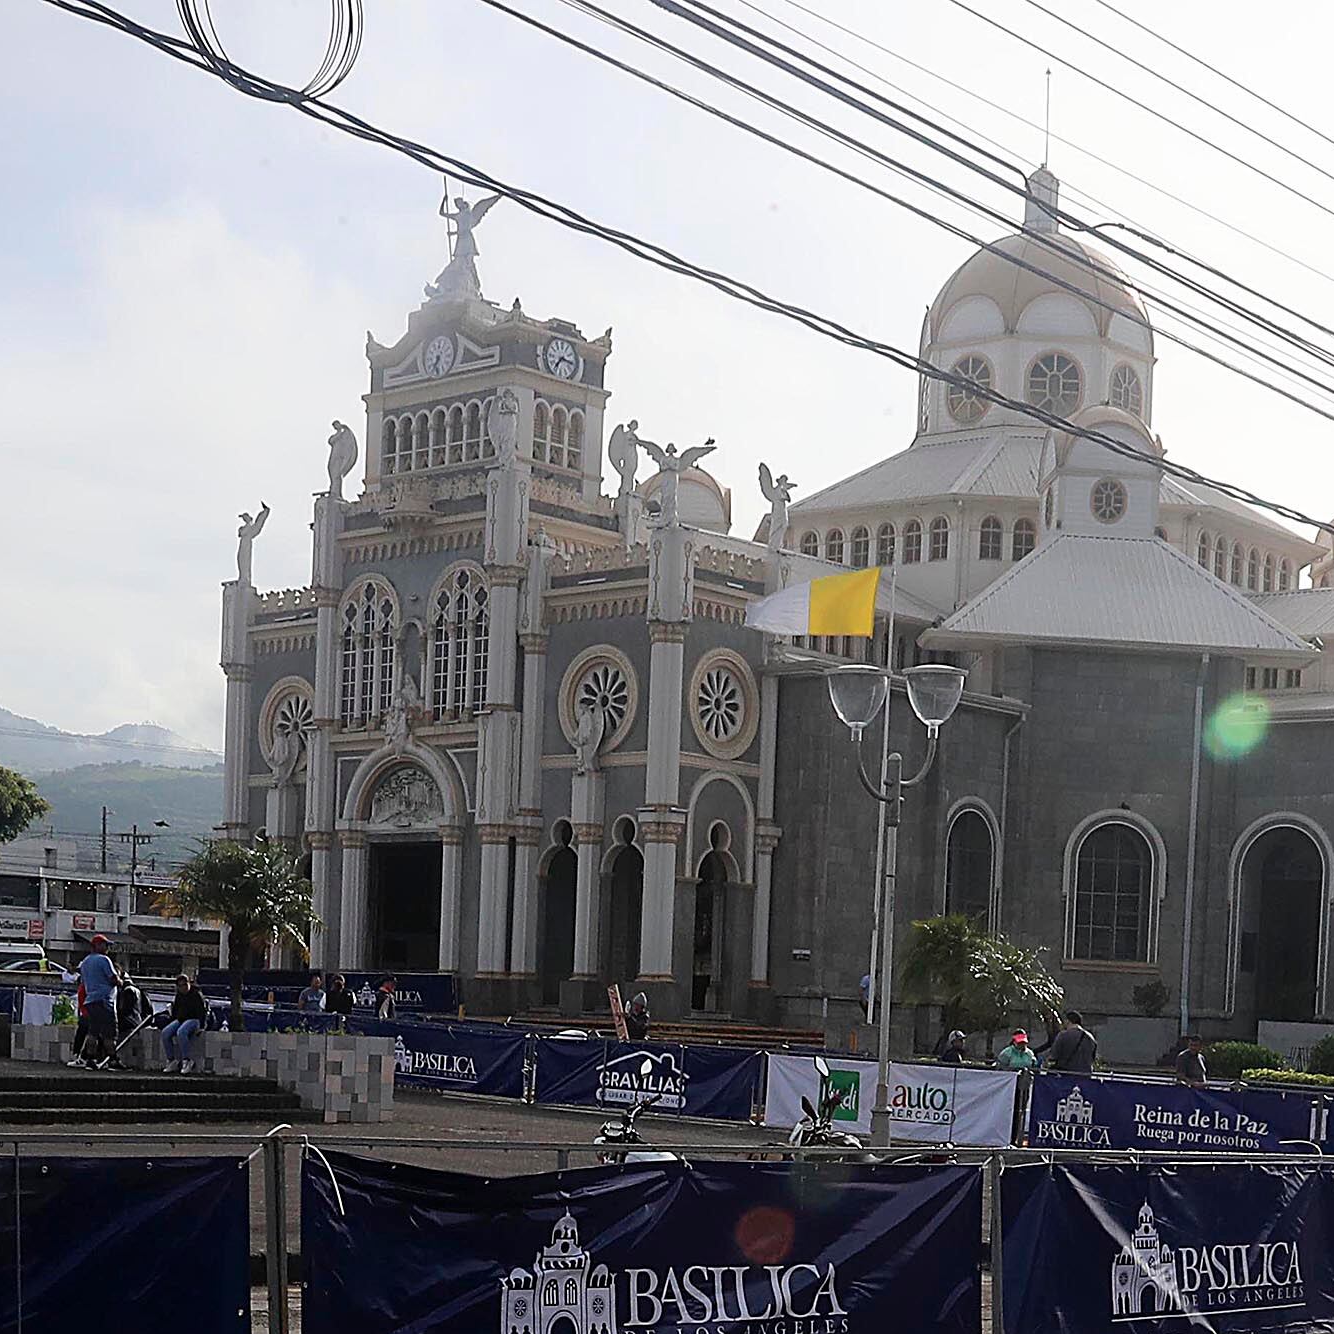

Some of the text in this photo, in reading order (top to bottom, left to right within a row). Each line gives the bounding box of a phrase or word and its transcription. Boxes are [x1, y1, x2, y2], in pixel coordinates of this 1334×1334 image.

[414, 1051, 477, 1075] BASILICA
[599, 1071, 685, 1093] GRAVILIAS
[892, 1083, 947, 1111] auto
[1134, 1103, 1269, 1136] Reina de la Paz
[1037, 1121, 1112, 1145] BASILICA
[1136, 1124, 1260, 1150] Ruega por nosotros
[1178, 1241, 1304, 1292] BASILICA
[624, 1262, 848, 1326] BASILICA
[1181, 1285, 1304, 1307] DE LOS ANGELES
